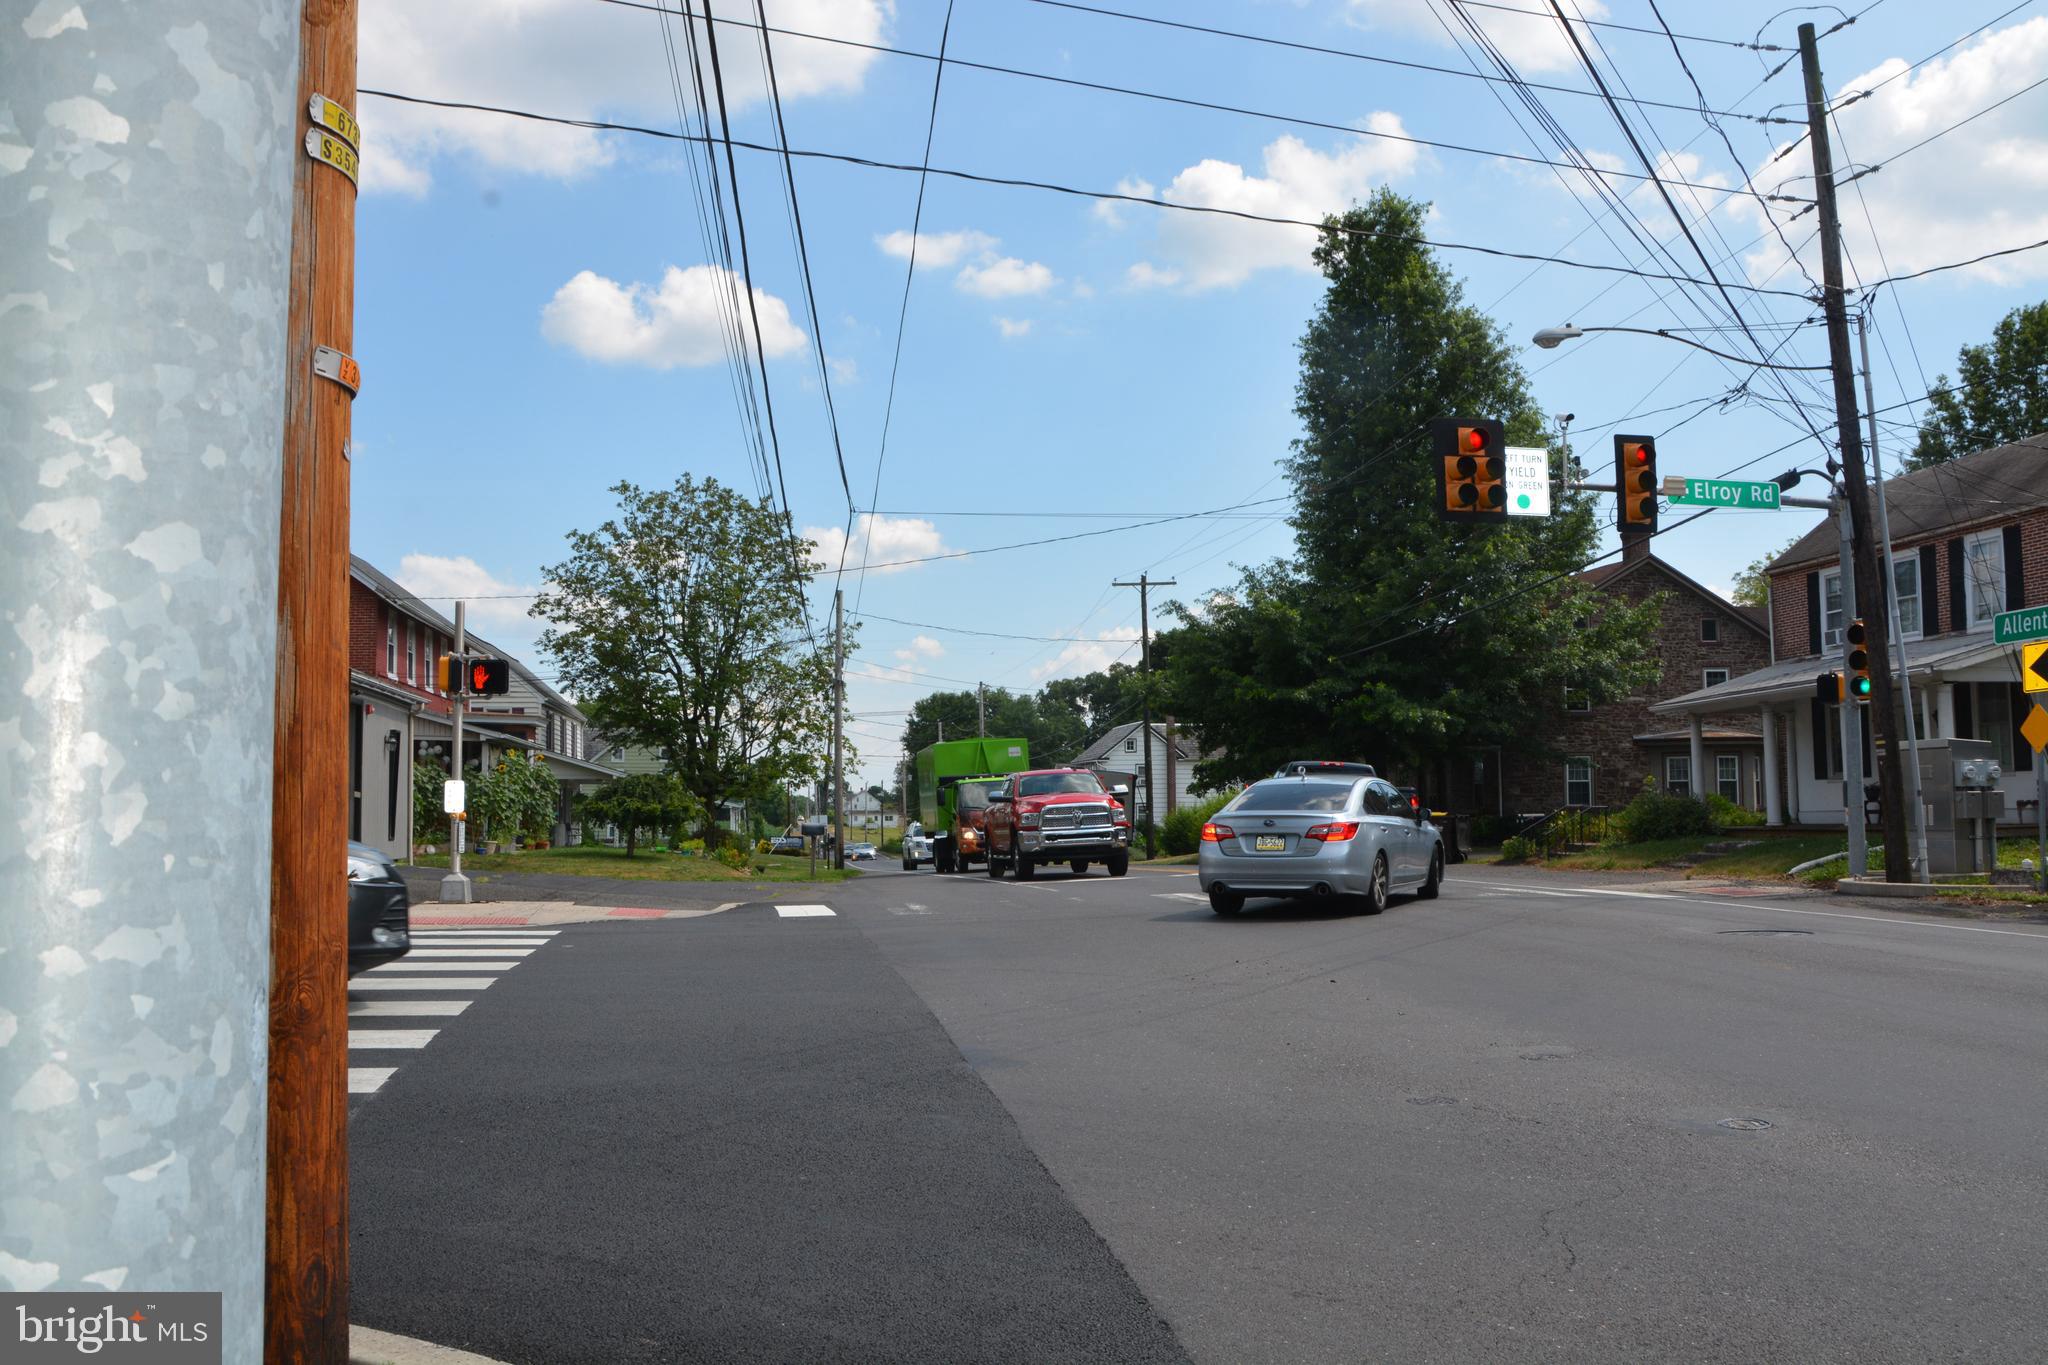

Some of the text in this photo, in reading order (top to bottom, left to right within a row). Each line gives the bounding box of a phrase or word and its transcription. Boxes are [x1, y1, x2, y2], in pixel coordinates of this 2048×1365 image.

[1522, 455, 1542, 463] TURN
[1509, 467, 1536, 478] YIELD
[1519, 481, 1543, 490] GREEN
[1694, 482, 1742, 504] Elroy
[1751, 485, 1773, 502] Rd
[2003, 611, 2048, 635] Allent
